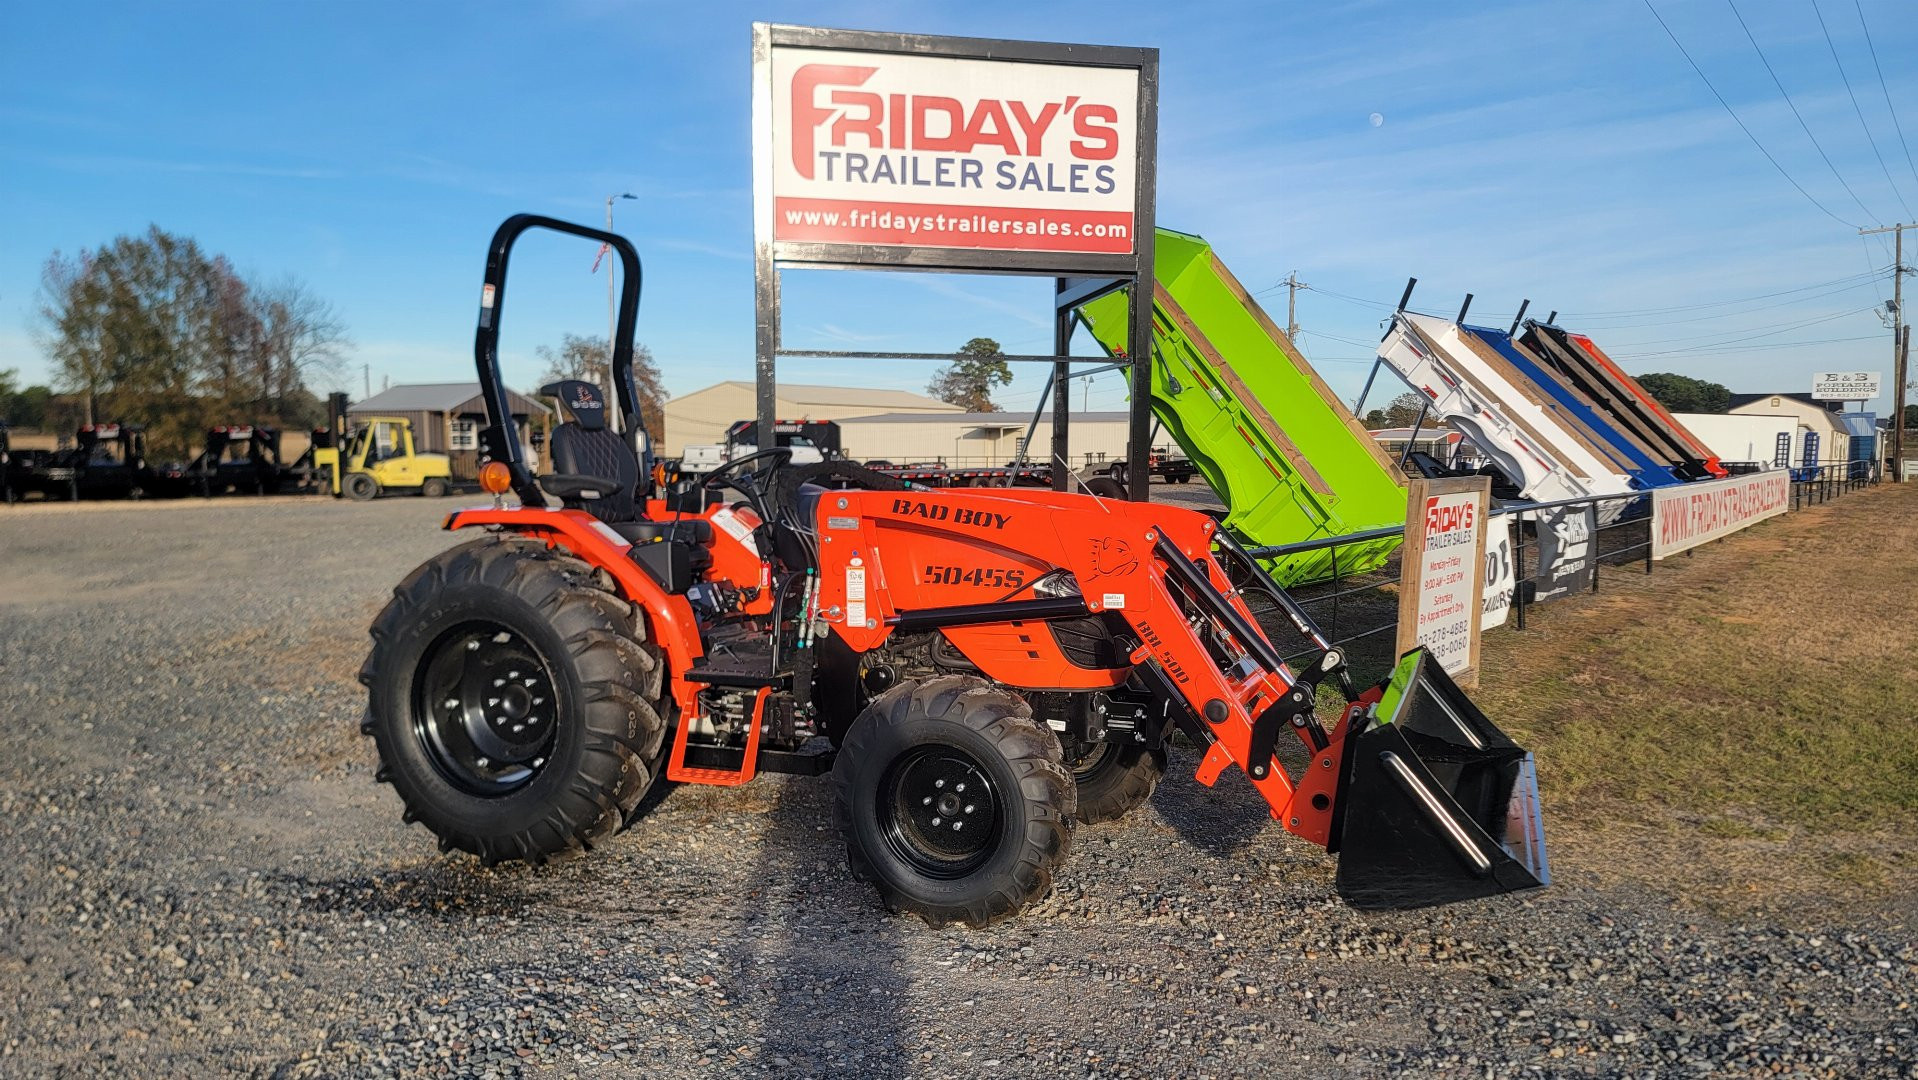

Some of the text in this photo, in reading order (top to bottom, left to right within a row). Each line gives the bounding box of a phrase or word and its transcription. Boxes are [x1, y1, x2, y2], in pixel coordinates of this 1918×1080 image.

[791, 63, 1119, 181] FRIDAY'S
[819, 151, 1116, 195] TRAILER SALES
[785, 208, 1128, 239] www.fridaystrailersales.com
[892, 499, 1012, 530] BAD BOY
[1423, 497, 1473, 552] FRIDAY'S
[1426, 529, 1472, 551] TRAILER SALES
[924, 565, 1025, 588] 5045S
[1418, 619, 1468, 647] 03-278-4882
[1136, 620, 1190, 684] BBL 500
